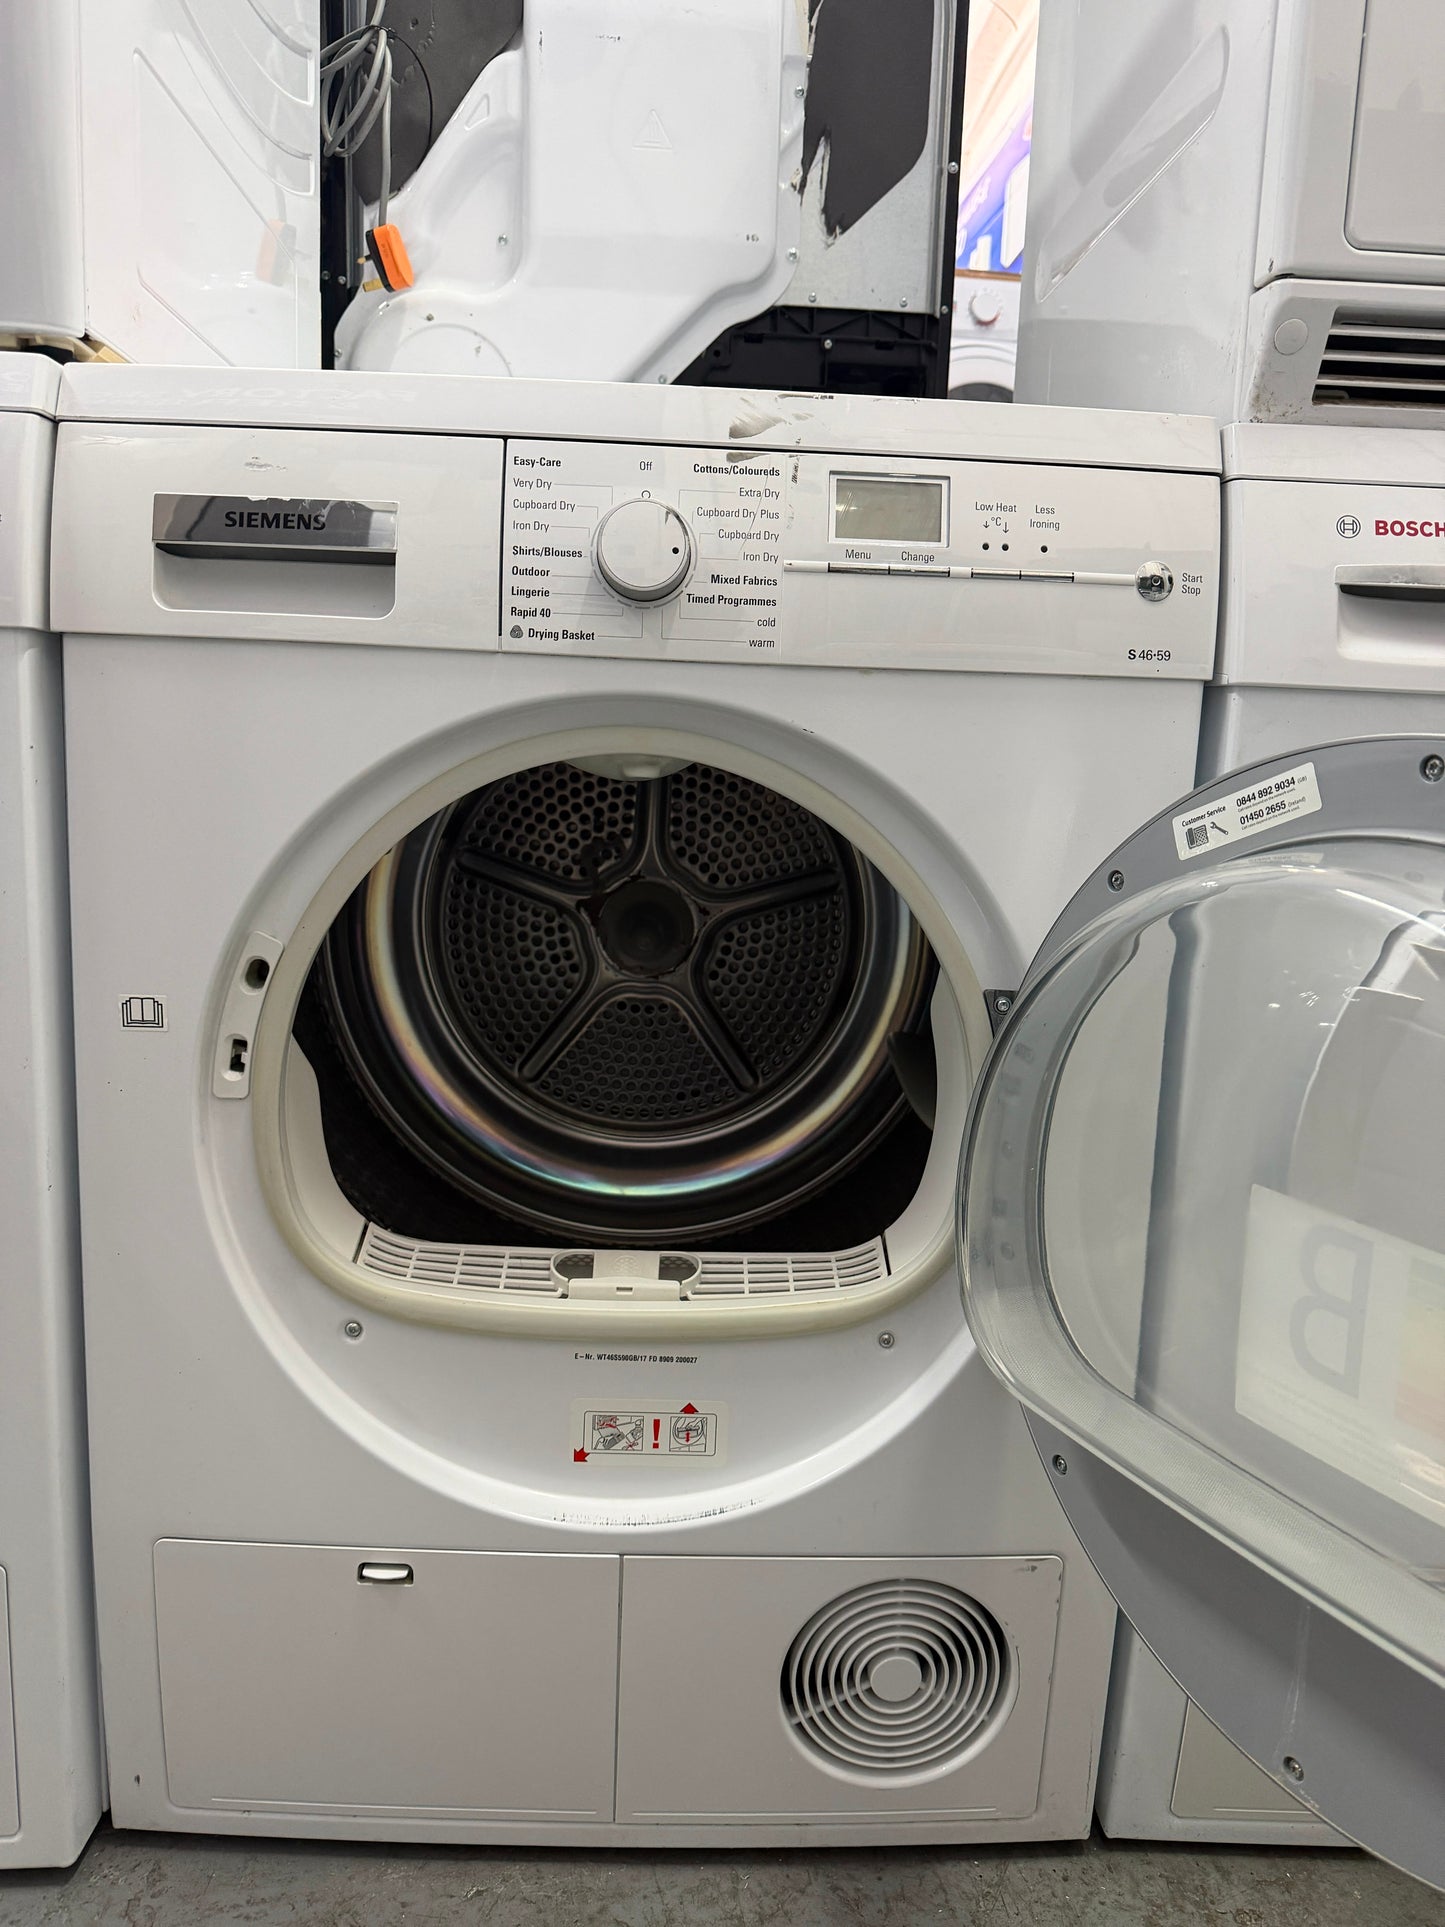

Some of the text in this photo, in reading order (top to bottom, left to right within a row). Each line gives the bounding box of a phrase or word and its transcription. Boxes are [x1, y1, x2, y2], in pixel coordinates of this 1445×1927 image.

[513, 456, 561, 468] Easy-Care
[639, 461, 652, 471] Off
[693, 463, 780, 477] Cottons/Coloureds
[513, 479, 552, 490] Very Dry
[739, 488, 780, 500] Extra Dry
[513, 499, 576, 512] Cupboard Dry
[975, 501, 1017, 513] Low Heat
[1035, 504, 1055, 515] Less
[696, 507, 780, 519] Cupboard Dry Plus
[224, 510, 327, 531] SIEMENS
[1029, 519, 1060, 531] Ironing
[513, 521, 550, 533] Iron Dry
[1375, 520, 1445, 537] BOSCH
[718, 529, 780, 542] Cupboard Dry
[512, 546, 583, 559] Shirts/Blouses
[743, 552, 779, 564] Iron Dry
[846, 549, 871, 560] Menu
[901, 551, 935, 564] Change
[512, 566, 550, 577] Outdoor
[711, 575, 778, 587] Mixed Fabrics
[1182, 573, 1203, 583] Start
[511, 586, 550, 599] Lingerie
[1181, 585, 1201, 596] Stop
[686, 594, 777, 608] Timed Programmes
[511, 607, 551, 619] Rapid 40
[757, 617, 776, 627] cold
[528, 628, 595, 642] Drying Basket
[749, 638, 775, 648] warm
[1128, 650, 1136, 661] S
[1236, 793, 1256, 807] 0844
[1258, 786, 1273, 799] 892
[1275, 777, 1296, 792] 9034
[1182, 805, 1226, 827] Customer Service
[1240, 809, 1264, 825] 01450
[1265, 800, 1286, 815] 2655
